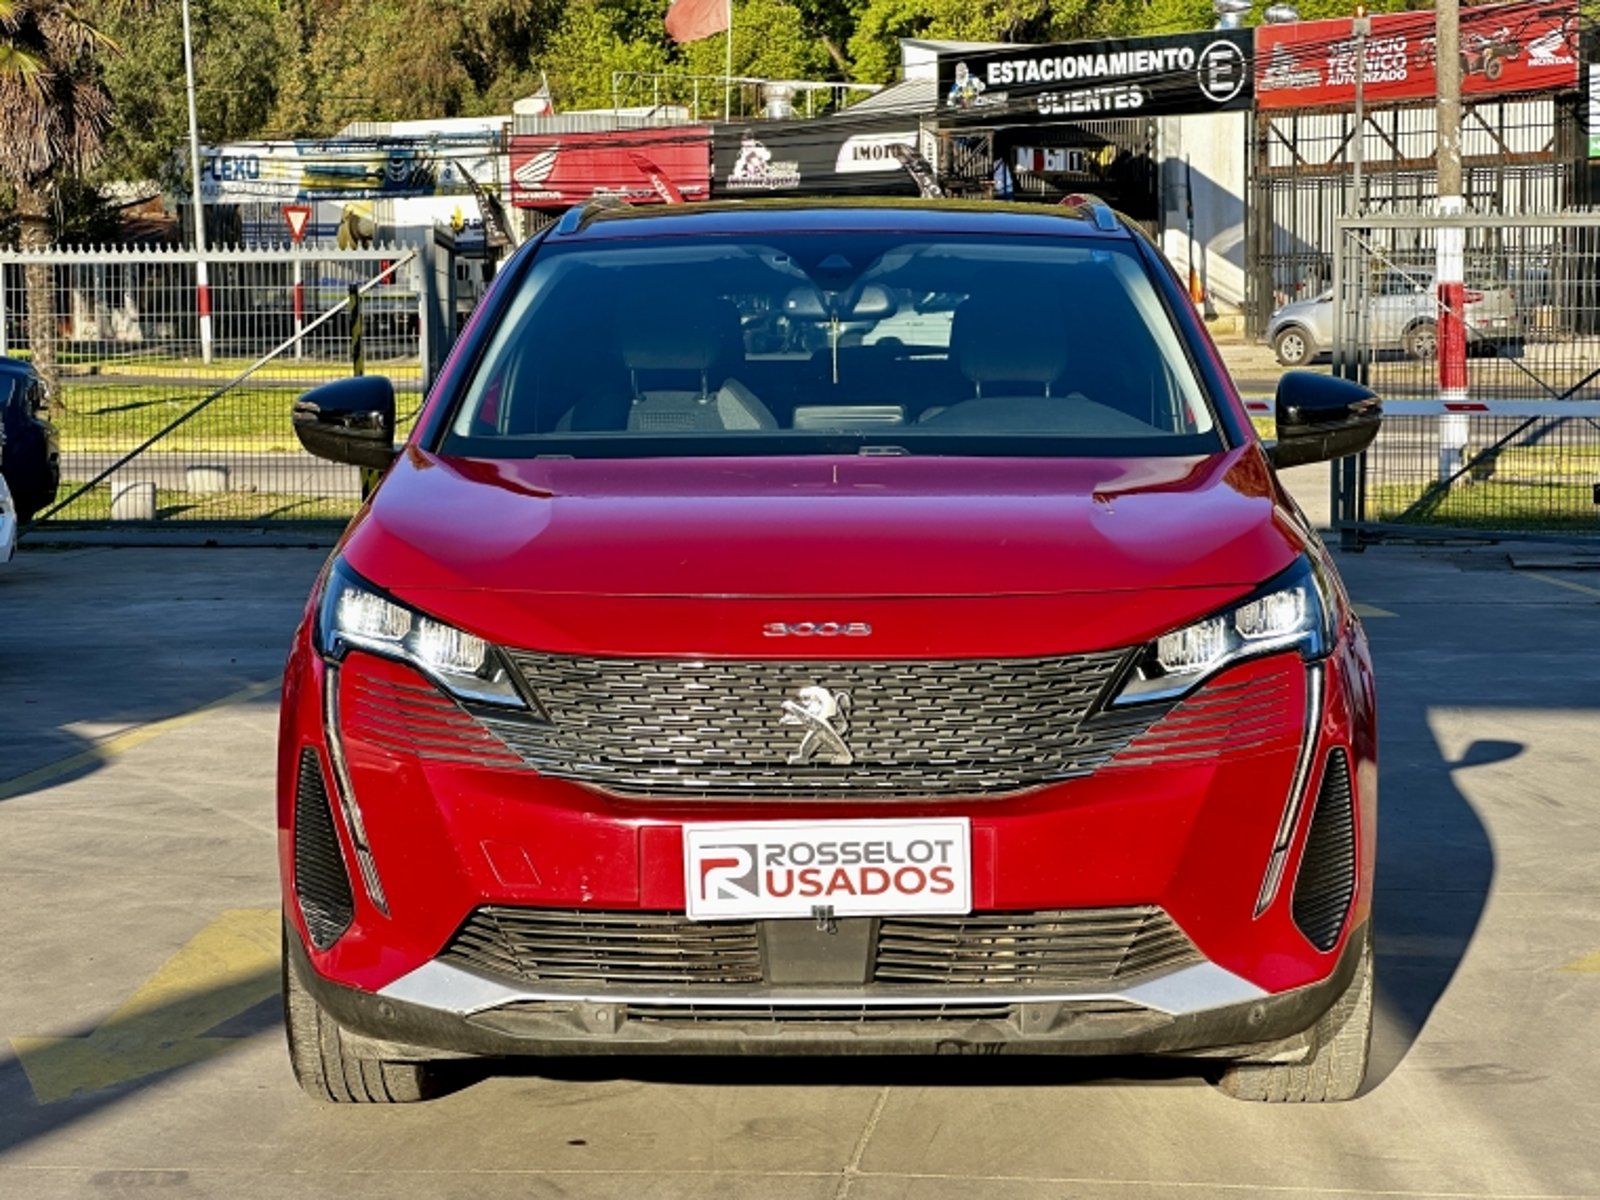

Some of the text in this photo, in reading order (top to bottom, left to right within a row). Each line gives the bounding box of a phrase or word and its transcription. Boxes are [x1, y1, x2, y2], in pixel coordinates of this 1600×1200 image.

[987, 47, 1195, 85] ESTACIONAMIENTO
[1528, 56, 1574, 67] HONDA
[1037, 85, 1144, 115] CLIENTES
[762, 622, 873, 636] 3008
[764, 840, 954, 866] ROSSELOT
[765, 867, 955, 897] USADOS
